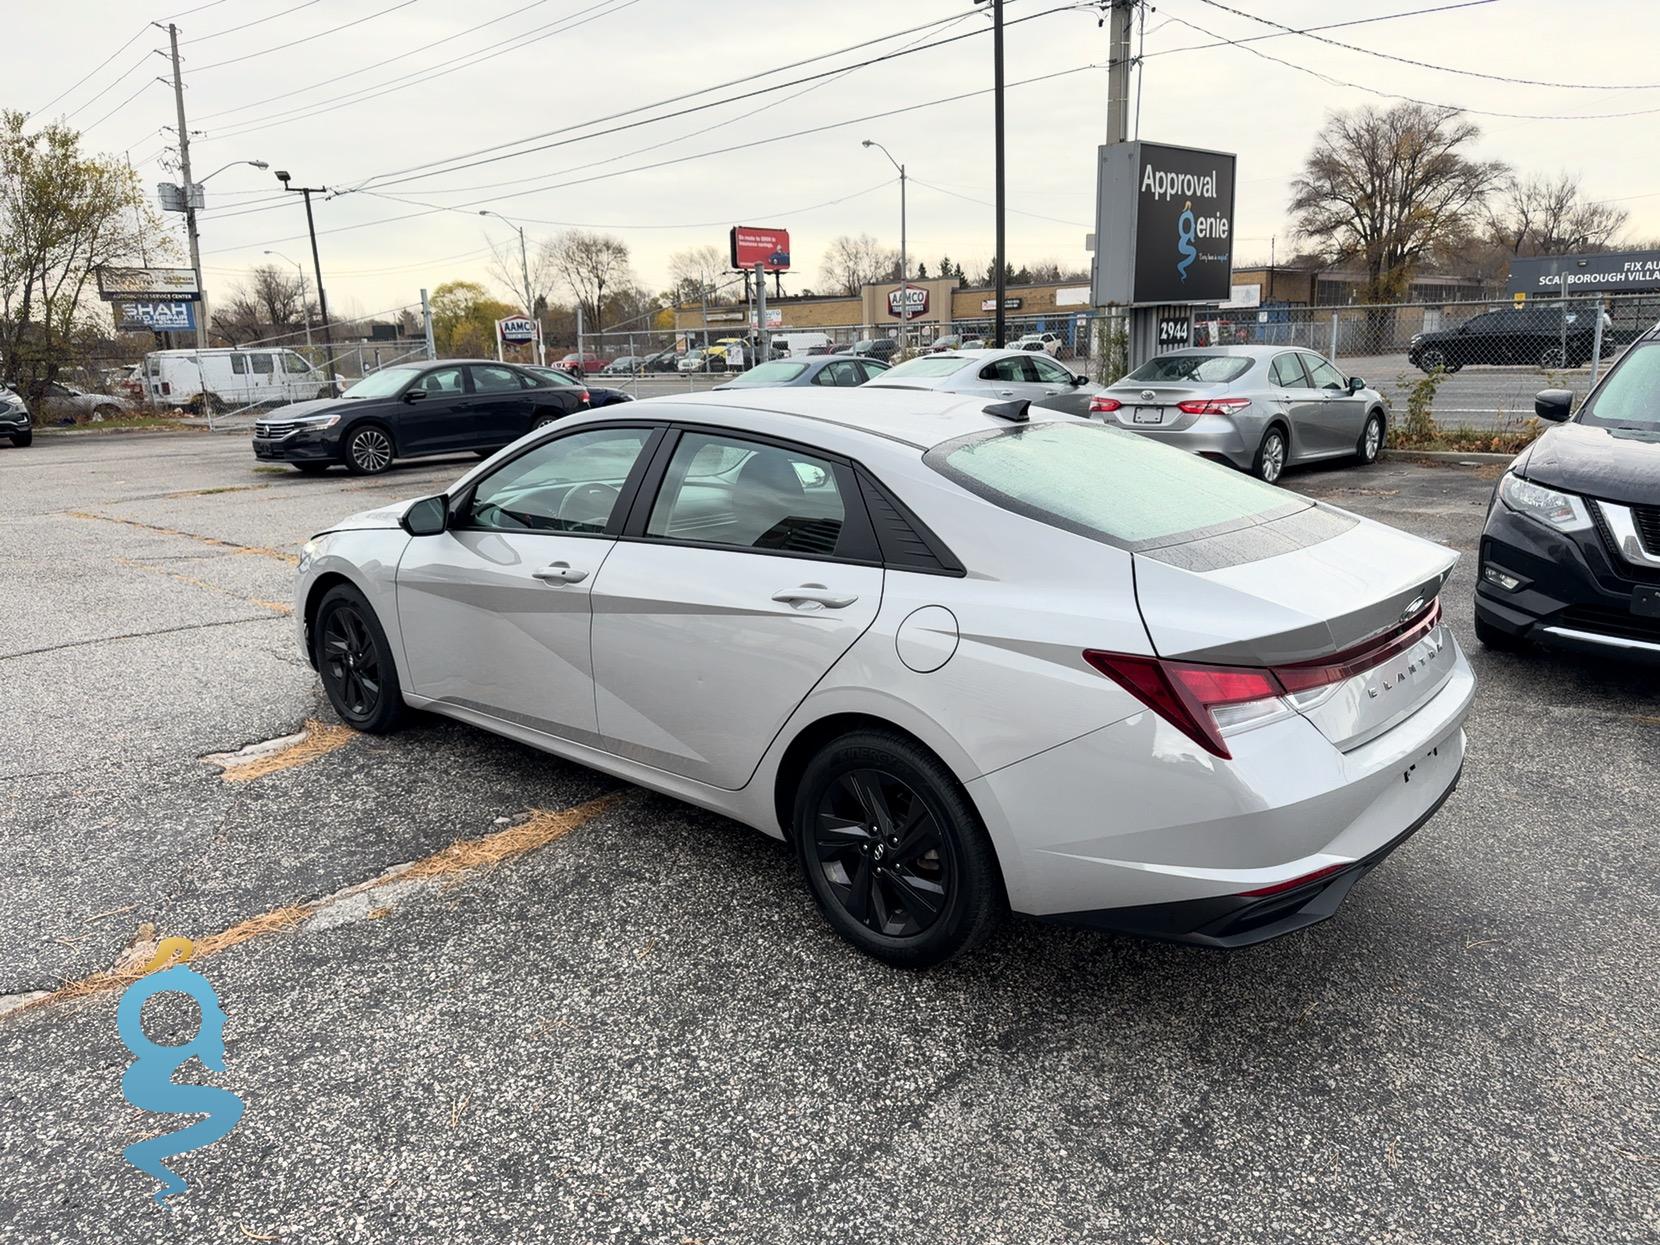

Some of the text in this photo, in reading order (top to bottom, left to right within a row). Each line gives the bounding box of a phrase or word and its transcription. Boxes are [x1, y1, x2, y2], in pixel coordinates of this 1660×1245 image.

[1141, 164, 1217, 201] Approval
[1623, 262, 1642, 272] FIX
[1539, 272, 1625, 285] SCABOROUGH
[121, 303, 187, 316] SHAH
[153, 314, 188, 322] REPAIR
[1160, 321, 1188, 340] 2944
[1367, 644, 1443, 699] ELANTRA
